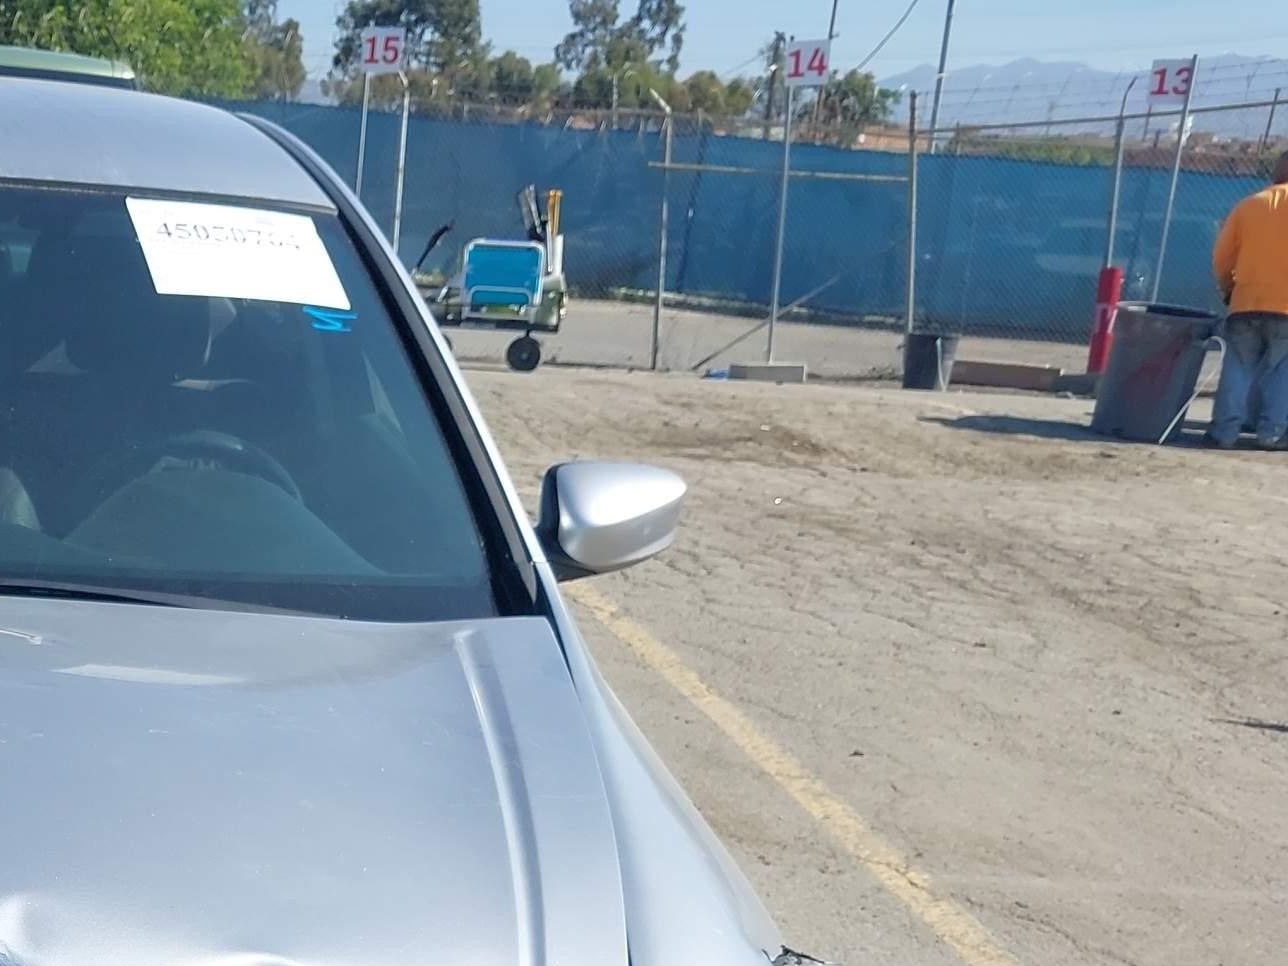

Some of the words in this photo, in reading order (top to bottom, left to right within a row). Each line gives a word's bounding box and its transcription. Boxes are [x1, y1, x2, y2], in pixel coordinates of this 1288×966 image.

[364, 36, 400, 65] 15
[787, 48, 827, 78] 14
[1150, 67, 1192, 95] 13
